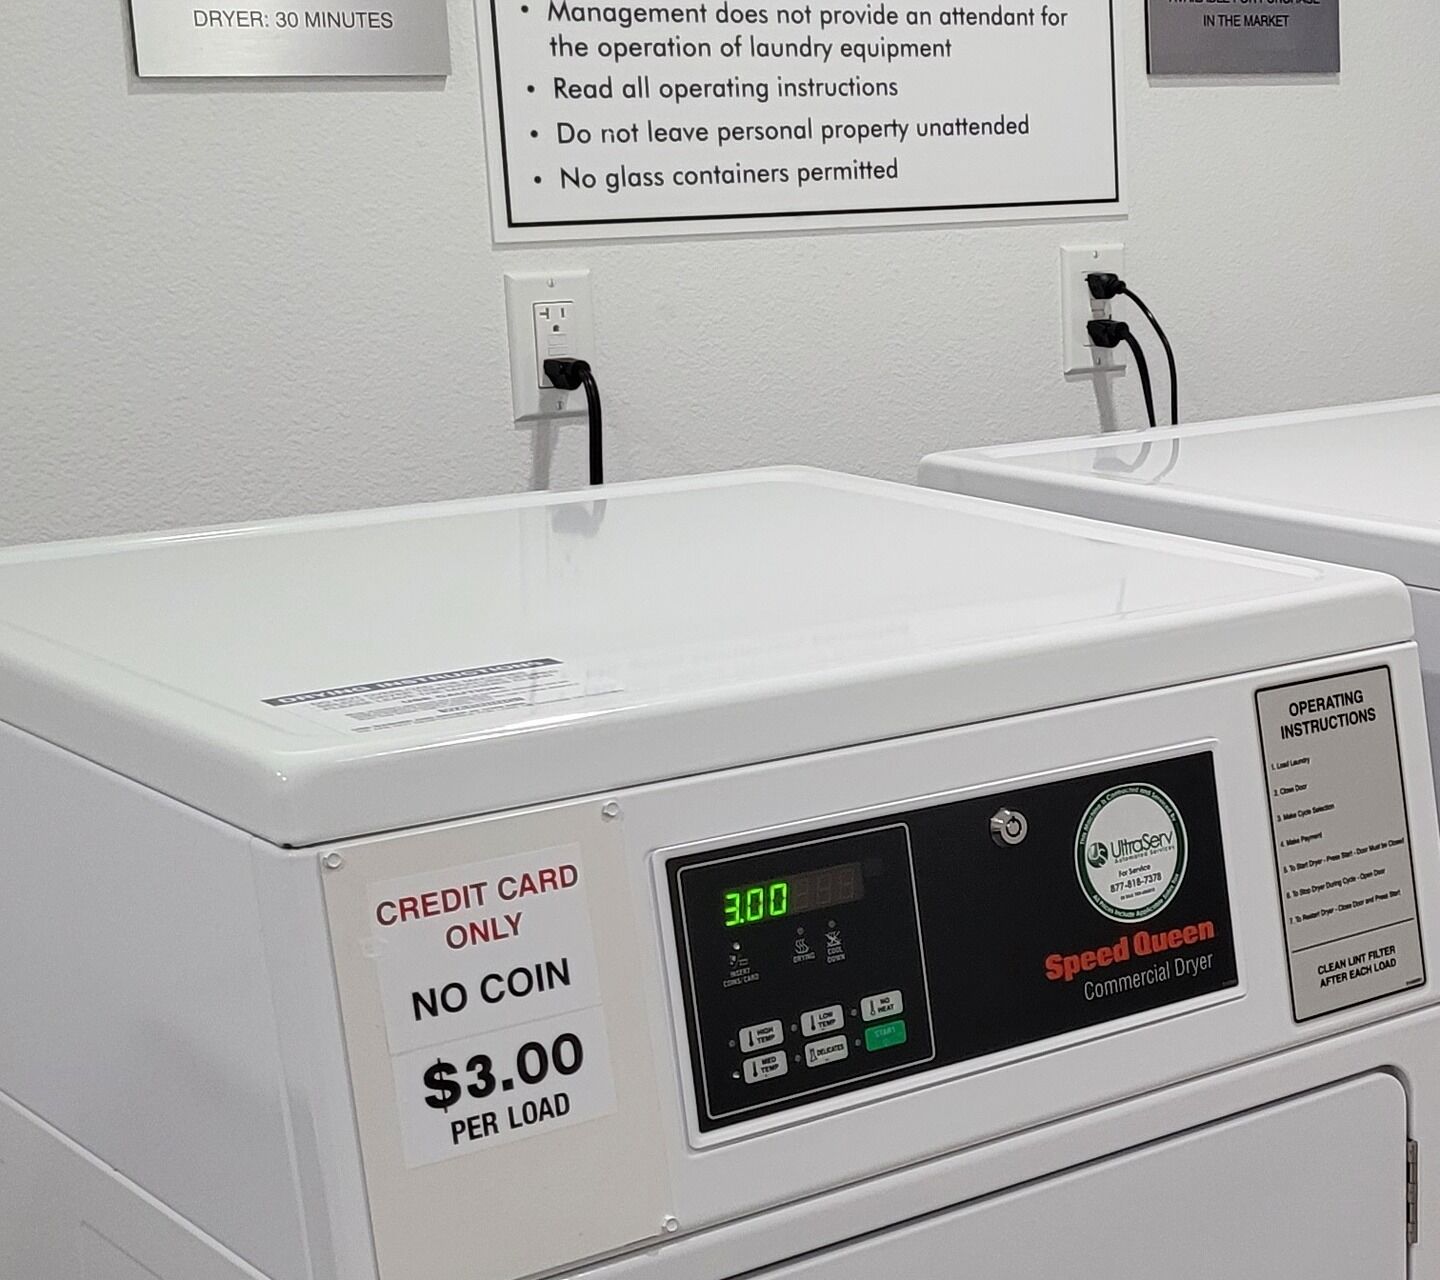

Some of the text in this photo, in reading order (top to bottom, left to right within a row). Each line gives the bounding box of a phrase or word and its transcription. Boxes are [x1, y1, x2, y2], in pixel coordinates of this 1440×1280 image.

[193, 10, 393, 29] DRYER: 30 MINUTES
[547, 0, 1068, 30] Management does not provide an attendant for
[1203, 14, 1290, 27] IN THE MARKET
[549, 33, 952, 63] the operation of laundry equipment
[553, 75, 898, 104] Read all operating instructions
[556, 113, 1029, 147] Do not leave personal property unattended
[560, 156, 898, 193] No glass containers permitted
[277, 660, 545, 703] DRYING INSTRUCTIONS
[1288, 689, 1363, 716] OPERATING
[1280, 707, 1376, 739] INSTRUCTIONS
[1111, 831, 1173, 858] UltraServ
[1118, 864, 1151, 878] For Service
[376, 864, 578, 926] CREDIT CARD
[725, 882, 787, 926] 3.00
[446, 911, 522, 949] ONLY
[1045, 920, 1214, 981] Speed Queen
[1317, 945, 1396, 975] CLEAN LINT FILTER
[1084, 953, 1213, 1000] Commercial Dryer
[1320, 957, 1396, 988] AFTER EACH LOAD
[411, 957, 570, 1021] NO COIN
[756, 1034, 776, 1044] TEMP
[818, 1019, 837, 1029] TEMP
[423, 1032, 583, 1113] $3.00
[760, 1063, 780, 1073] TEMP
[450, 1092, 570, 1145] PER LOAD
